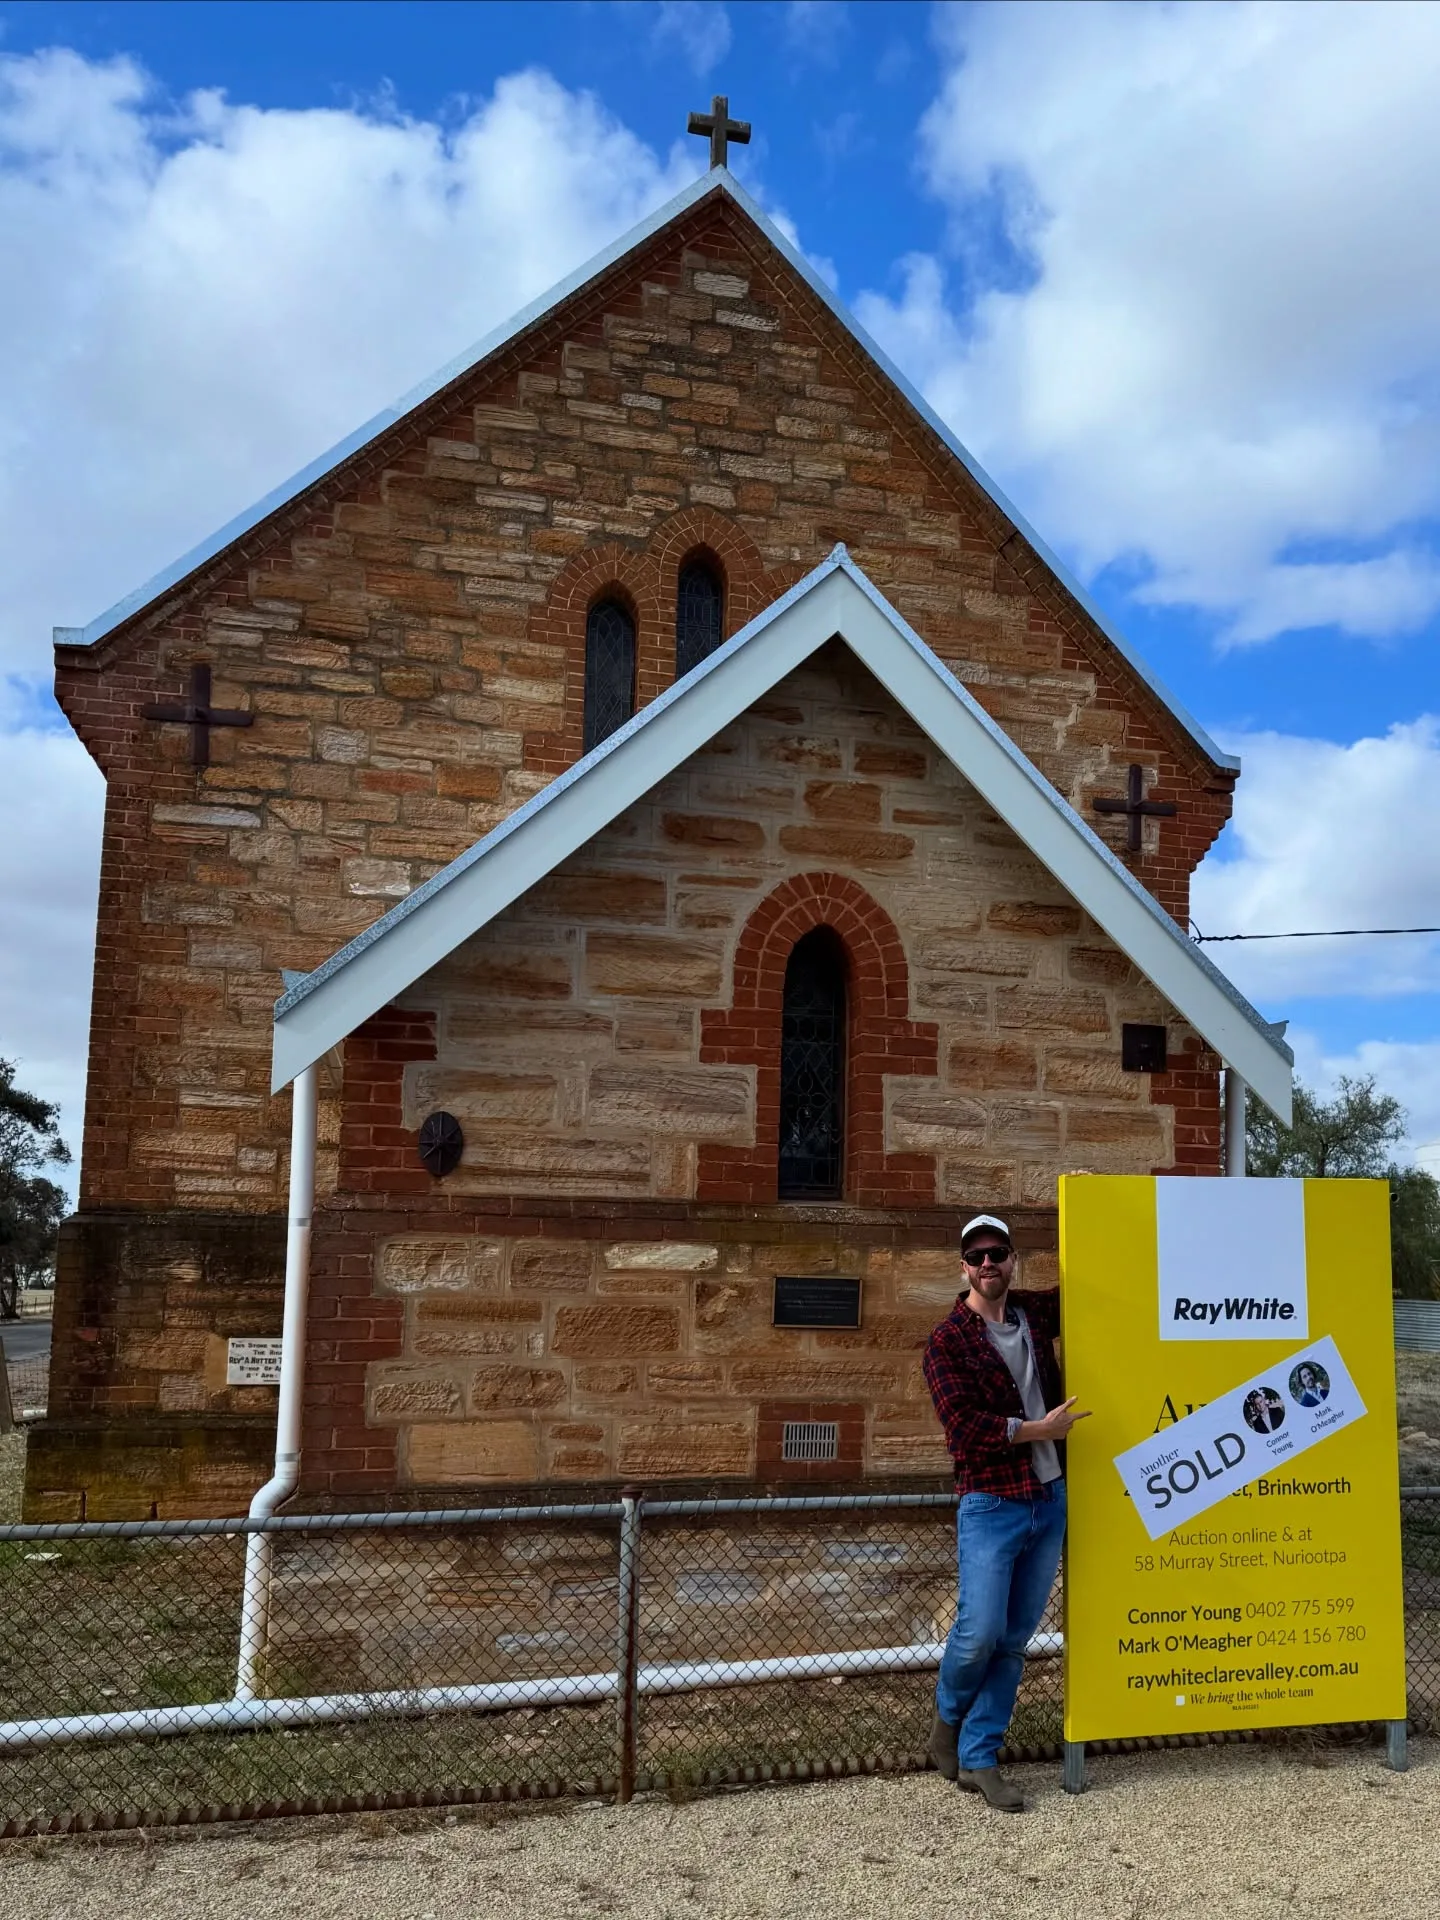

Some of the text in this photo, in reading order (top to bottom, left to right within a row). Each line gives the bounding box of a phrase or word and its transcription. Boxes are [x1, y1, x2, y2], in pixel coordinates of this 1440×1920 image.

[1310, 1410, 1345, 1433] O'Meagher
[1314, 1406, 1332, 1420] Mark
[1266, 1431, 1289, 1448] Connor
[1271, 1441, 1294, 1456] Young
[1140, 1448, 1180, 1478] Another
[1146, 1432, 1246, 1509] SOLD
[1258, 1477, 1351, 1496] Brinkworth
[1169, 1526, 1313, 1547] Auction online & at
[1134, 1548, 1347, 1575] 58 Murray Street, Nuriootpa
[1128, 1597, 1355, 1625] Connor Young 0402 775 599
[1118, 1625, 1366, 1655] Mark O'Meagher 0424 156 780
[1127, 1659, 1359, 1692] raywhiteclarevalley.com.au
[1190, 1687, 1314, 1705] We bring the whole team
